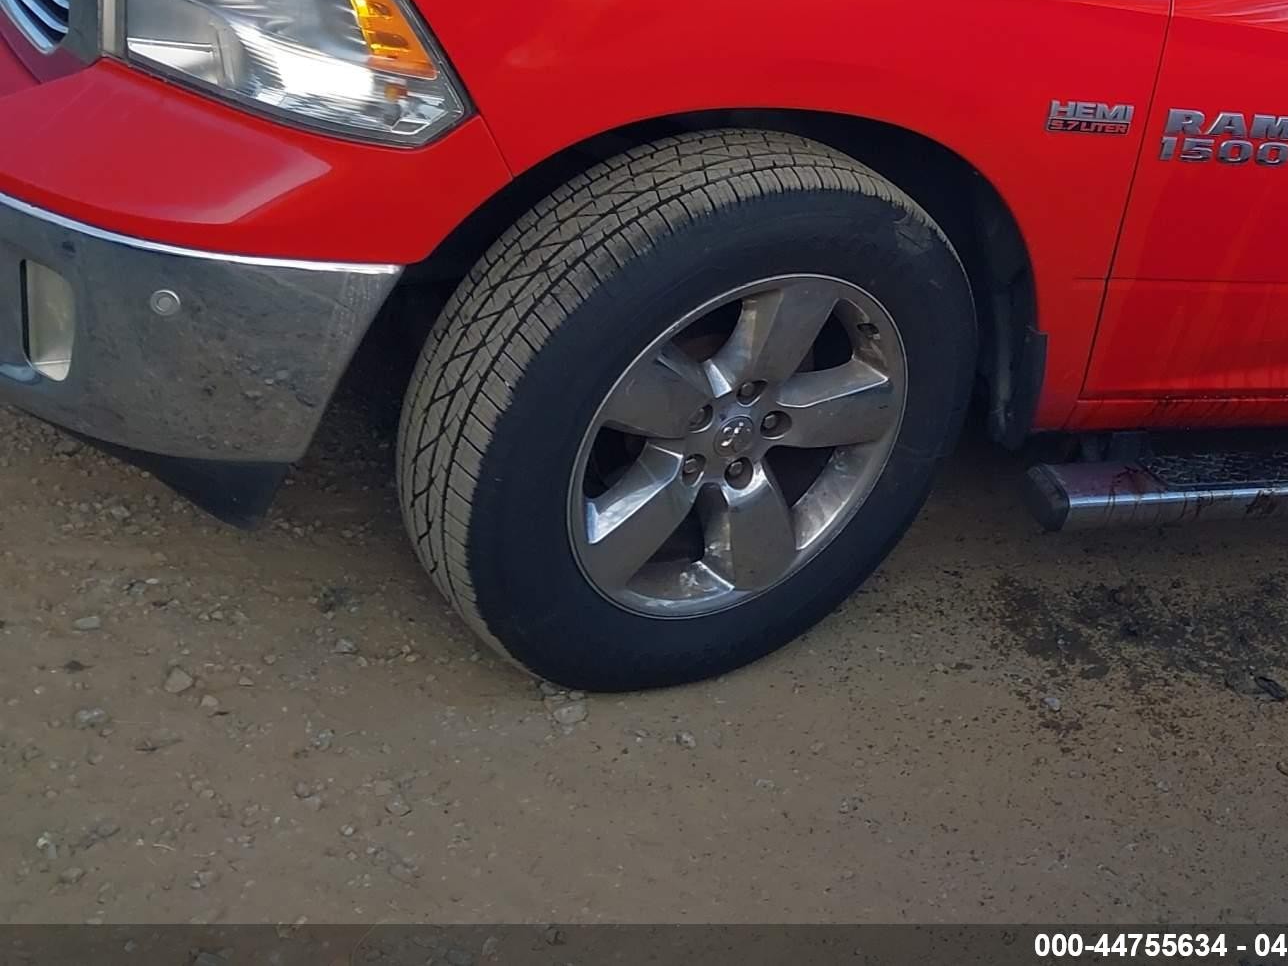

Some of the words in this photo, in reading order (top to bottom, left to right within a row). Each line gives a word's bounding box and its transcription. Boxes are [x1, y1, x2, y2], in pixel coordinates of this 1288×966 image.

[1050, 100, 1134, 121] HEMI
[1049, 119, 1078, 133] 5.7
[1080, 121, 1129, 135] LITER
